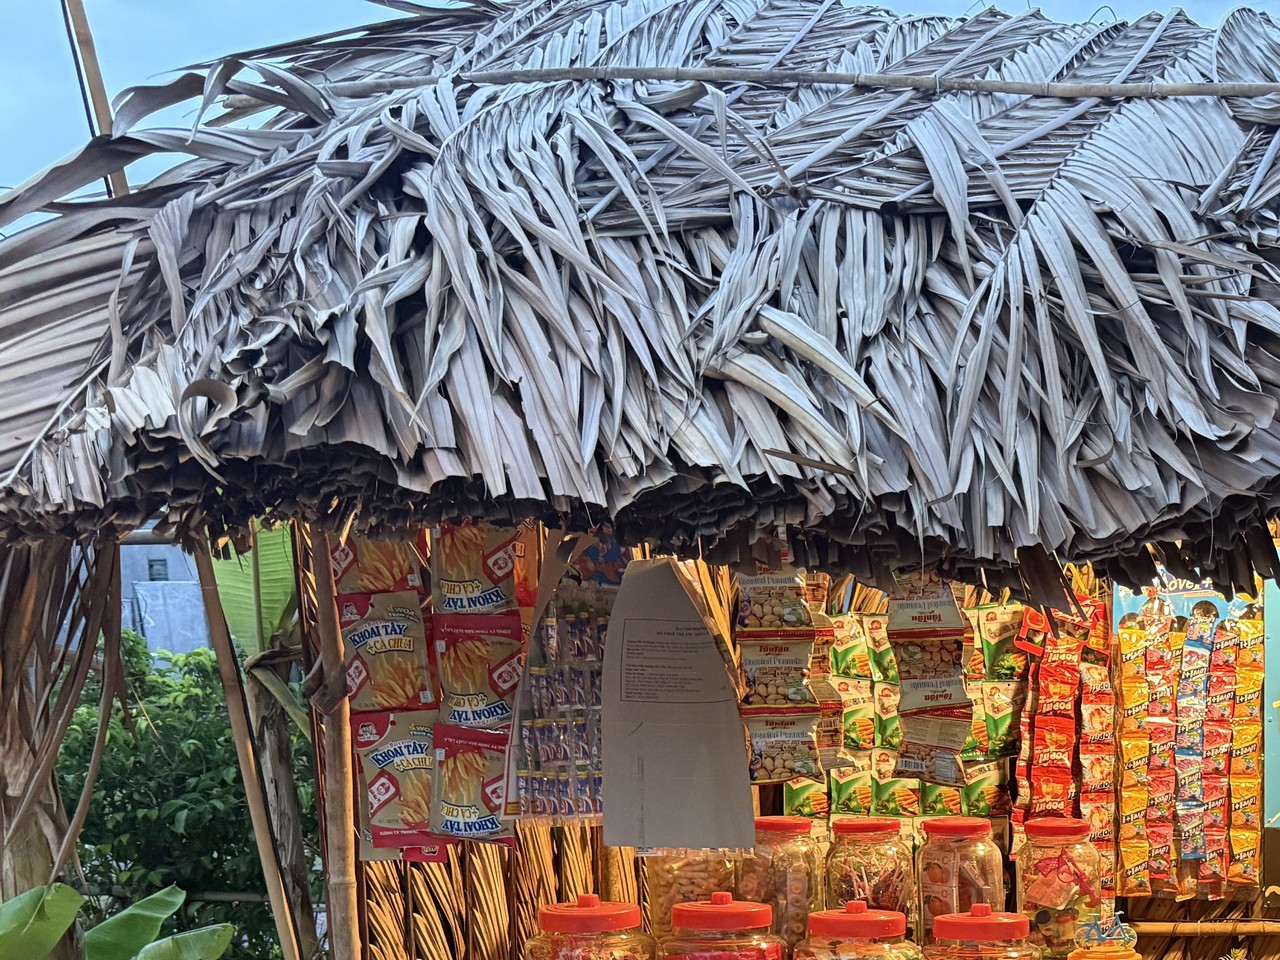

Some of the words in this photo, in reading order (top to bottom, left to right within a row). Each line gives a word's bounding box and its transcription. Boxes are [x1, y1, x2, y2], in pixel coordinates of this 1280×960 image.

[469, 589, 505, 607] KHOAI
[349, 625, 380, 646] KHOAI
[471, 703, 511, 720] KHOAI
[371, 746, 404, 768] KHOAI
[461, 817, 501, 832] KHOAI
